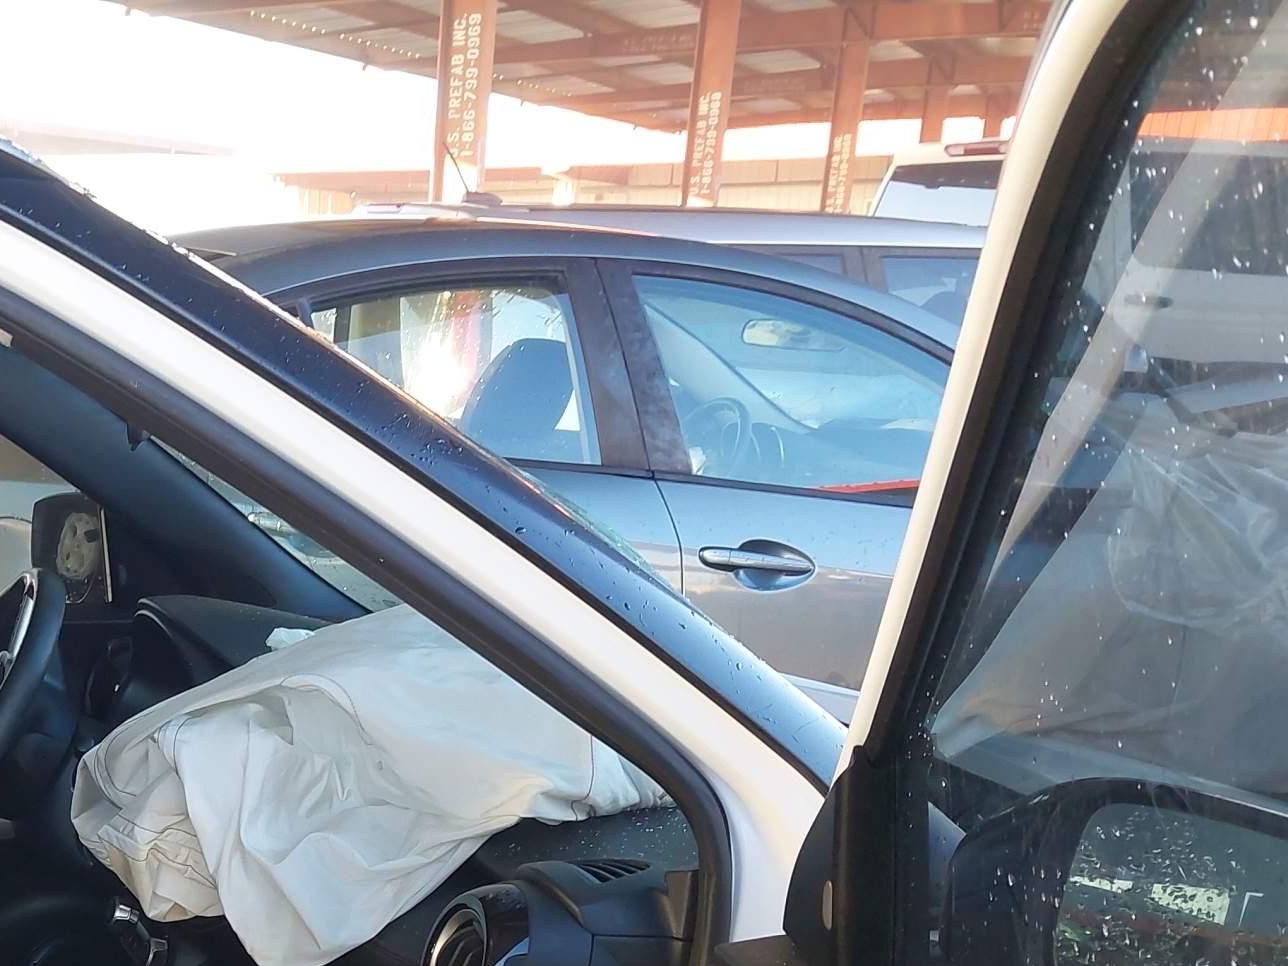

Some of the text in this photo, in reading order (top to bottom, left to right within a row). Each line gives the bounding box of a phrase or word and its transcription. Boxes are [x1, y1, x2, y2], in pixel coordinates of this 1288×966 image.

[452, 13, 468, 47] INC.
[448, 53, 465, 119] PREFAB
[460, 13, 482, 157] 1-866-799-0969
